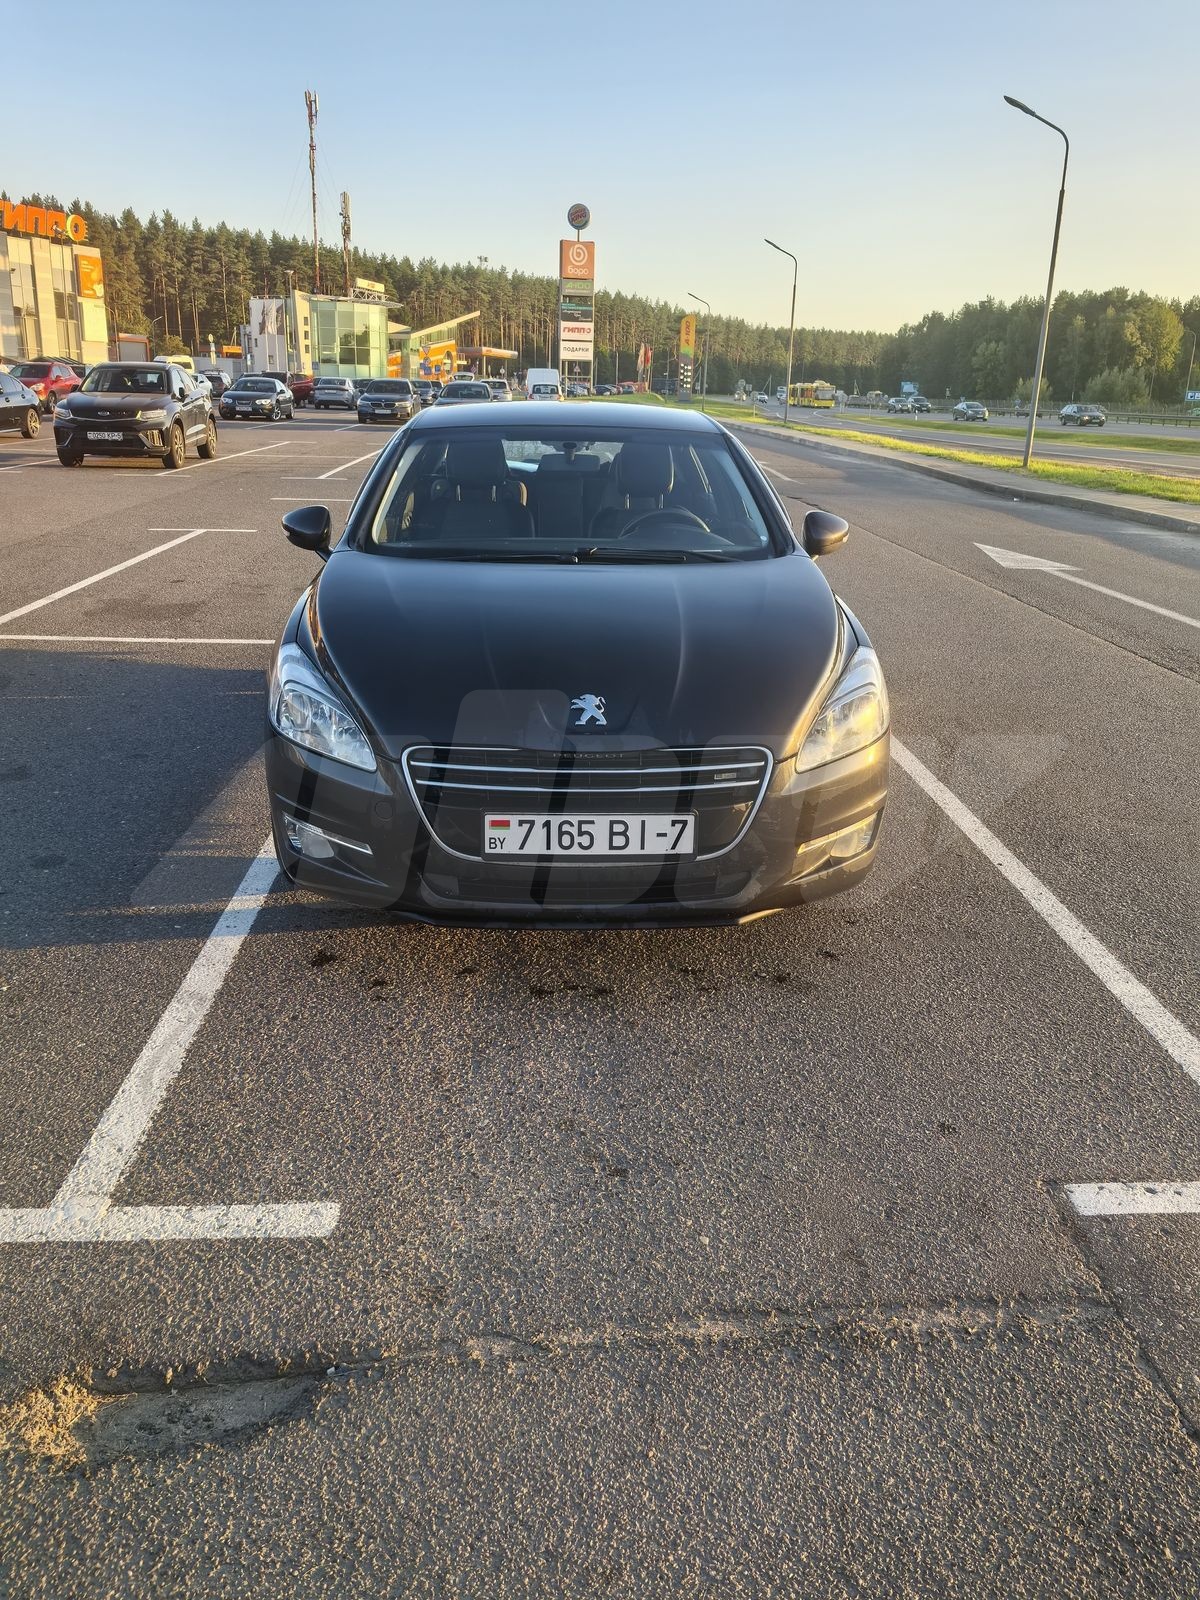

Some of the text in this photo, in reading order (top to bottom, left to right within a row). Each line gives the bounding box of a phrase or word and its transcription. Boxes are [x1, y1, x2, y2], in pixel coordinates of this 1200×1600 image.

[0, 199, 88, 242] ИППО
[563, 326, 592, 334] ГИППО
[488, 837, 506, 850] BY
[518, 819, 595, 850] 7165
